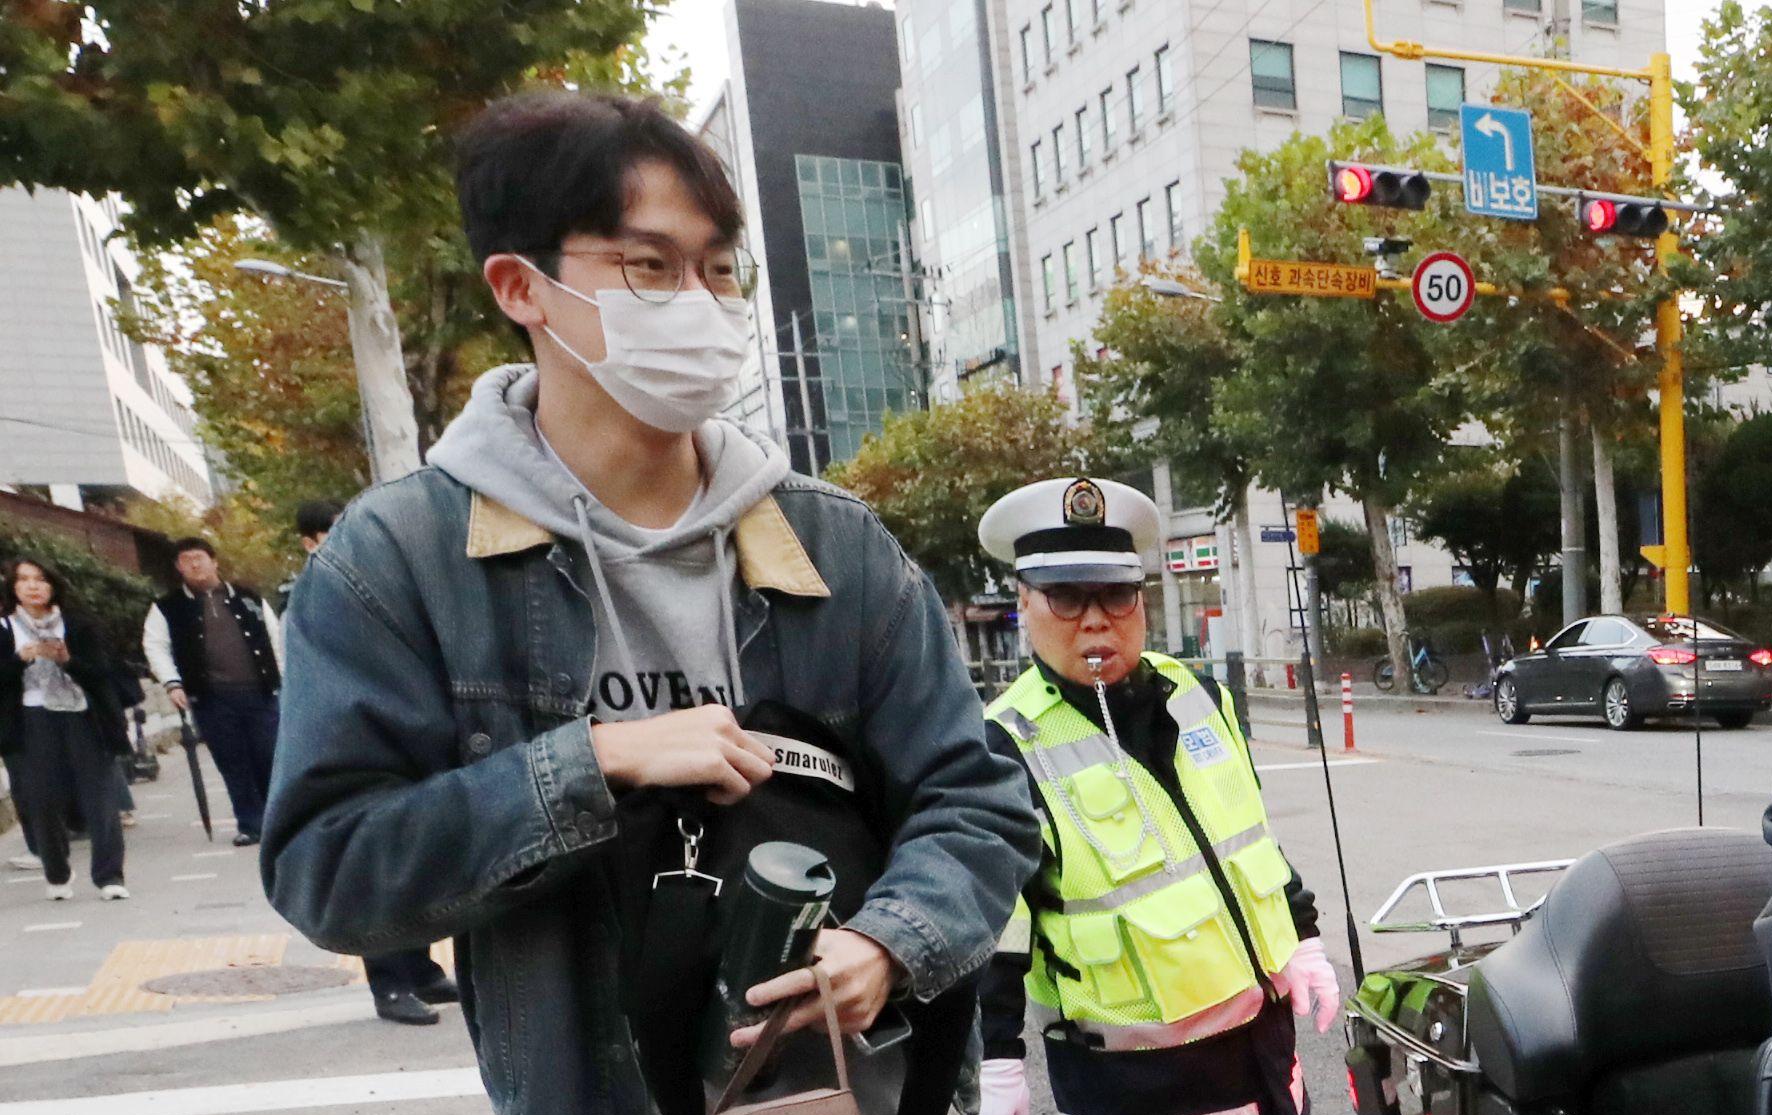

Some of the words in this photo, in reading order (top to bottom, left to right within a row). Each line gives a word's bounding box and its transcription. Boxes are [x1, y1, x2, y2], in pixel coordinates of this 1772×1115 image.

[1469, 169, 1534, 213] 비보호
[1255, 264, 1282, 287] 신호
[1288, 267, 1371, 292] 과속단속장비
[1426, 274, 1462, 302] 50
